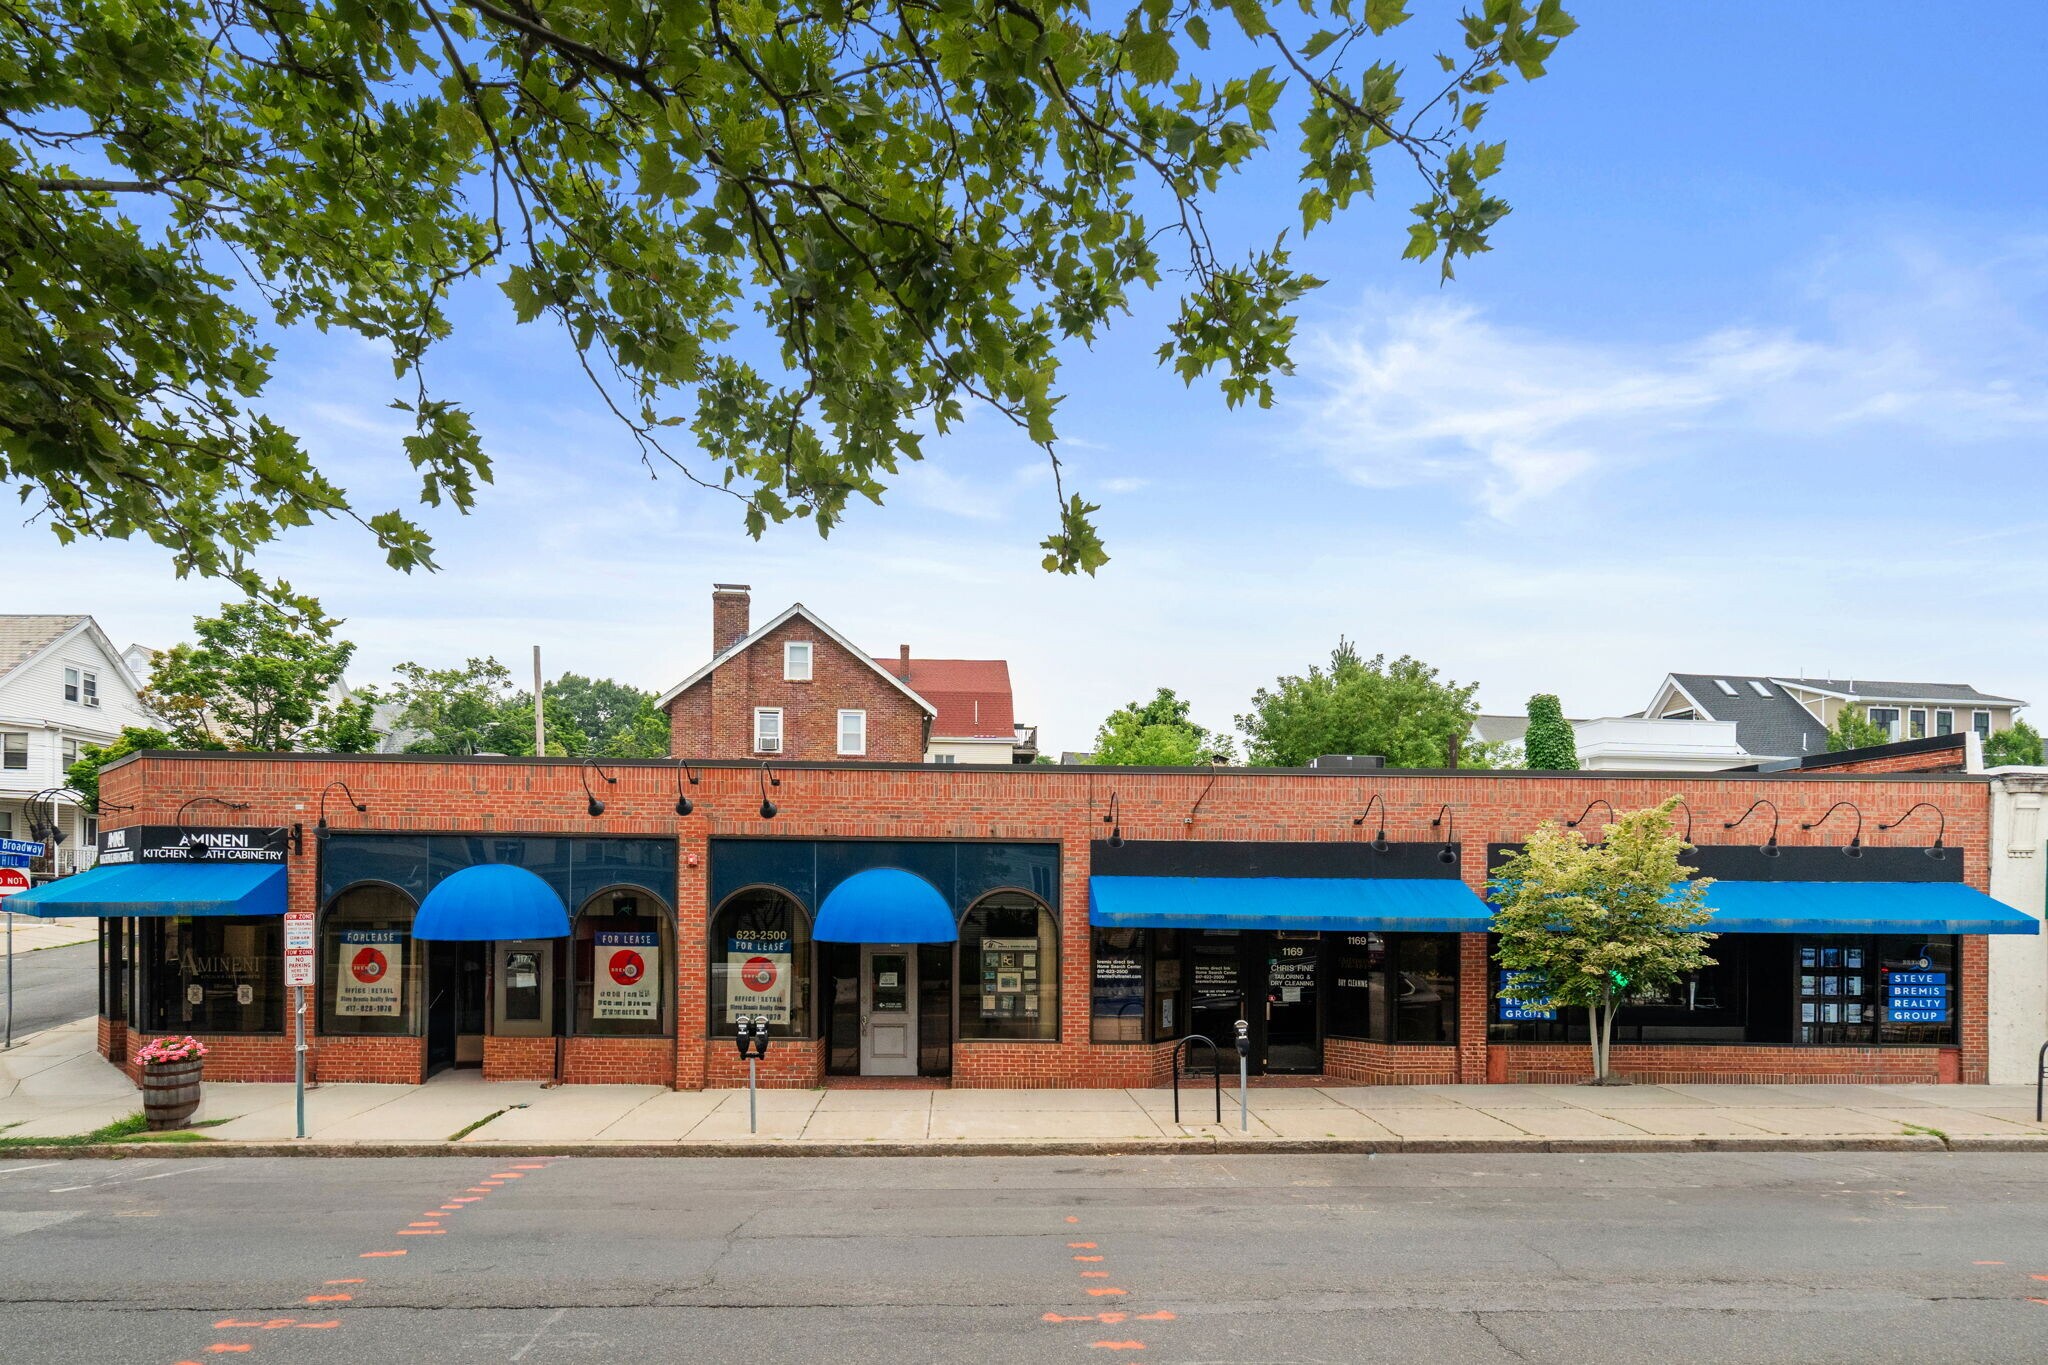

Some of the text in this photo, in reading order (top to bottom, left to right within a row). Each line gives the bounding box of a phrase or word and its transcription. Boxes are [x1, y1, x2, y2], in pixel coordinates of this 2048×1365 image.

[178, 834, 248, 847] AMINENI
[2, 840, 43, 855] Broadway
[143, 849, 187, 858] KITCHEN
[227, 851, 283, 860] CABINETRY
[1, 856, 19, 866] HILL
[347, 932, 394, 942] FOR LEASE
[602, 935, 651, 944] FOR LEASE
[736, 930, 787, 940] 623-2500
[1347, 936, 1367, 945] 1169
[735, 941, 784, 951] FOR LEASE
[1281, 947, 1304, 956] 1169
[178, 948, 259, 976] AMINENI
[1270, 964, 1314, 972] CHRIS FINE
[1894, 974, 1933, 983] STEVE
[1338, 979, 1368, 988] DRY CLEANING
[1894, 987, 1940, 995] BREMIS
[1894, 999, 1941, 1008] REALTY
[1894, 1012, 1937, 1020] GROUP
